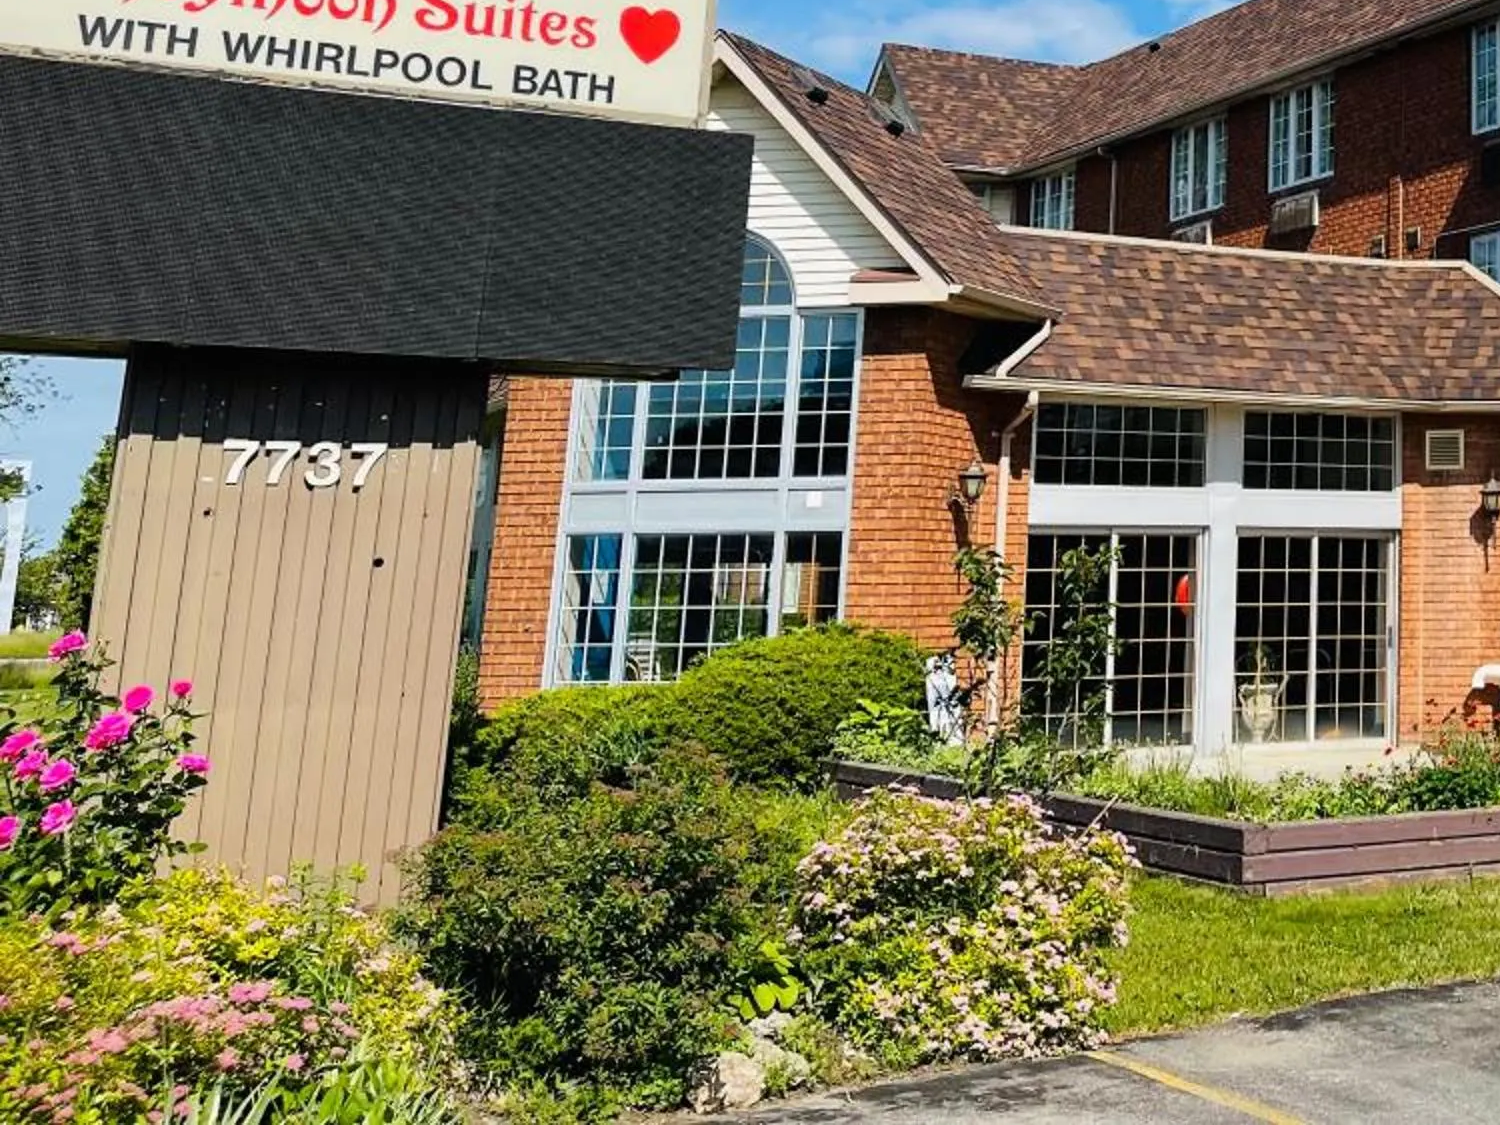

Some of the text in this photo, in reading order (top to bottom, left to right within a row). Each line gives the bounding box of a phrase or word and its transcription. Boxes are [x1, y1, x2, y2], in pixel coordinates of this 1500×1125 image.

[77, 13, 616, 104] WITH WHIRLPOOL BATH
[223, 440, 388, 489] 7737
